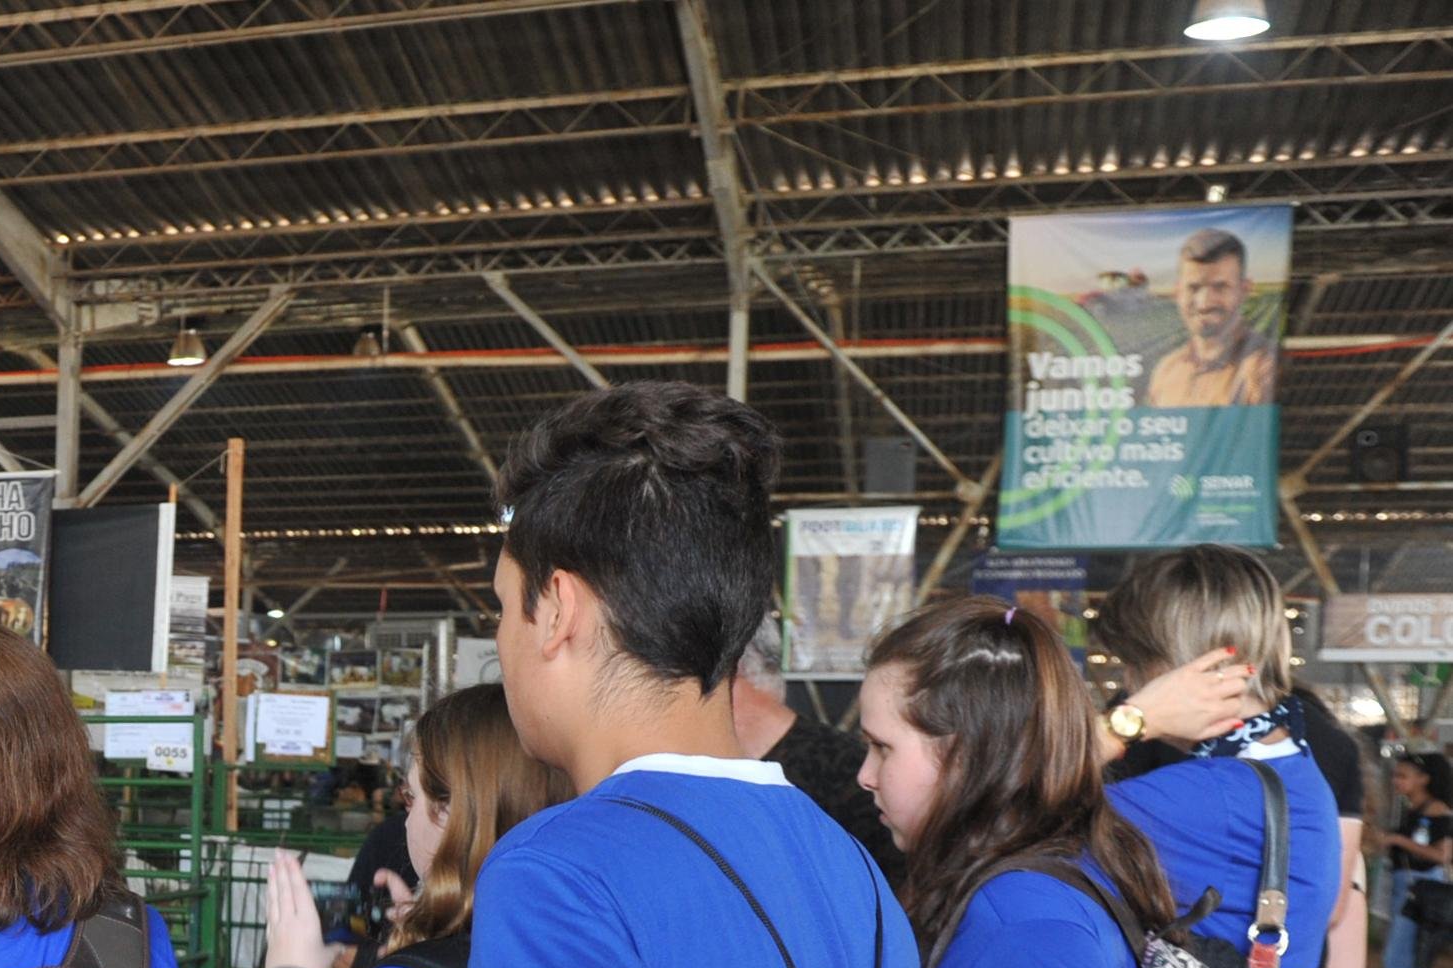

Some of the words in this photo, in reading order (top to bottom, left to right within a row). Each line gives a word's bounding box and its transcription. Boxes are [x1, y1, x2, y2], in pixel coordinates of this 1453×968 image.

[1027, 352, 1143, 379] Vamos
[1022, 380, 1135, 420] juntos
[1024, 413, 1110, 438] deixar
[1115, 418, 1134, 436] o
[1137, 416, 1188, 436] seu
[1023, 439, 1115, 464] cultivo
[1119, 436, 1185, 462] mais
[1022, 464, 1149, 489] eficiente.
[153, 745, 189, 760] 0055
